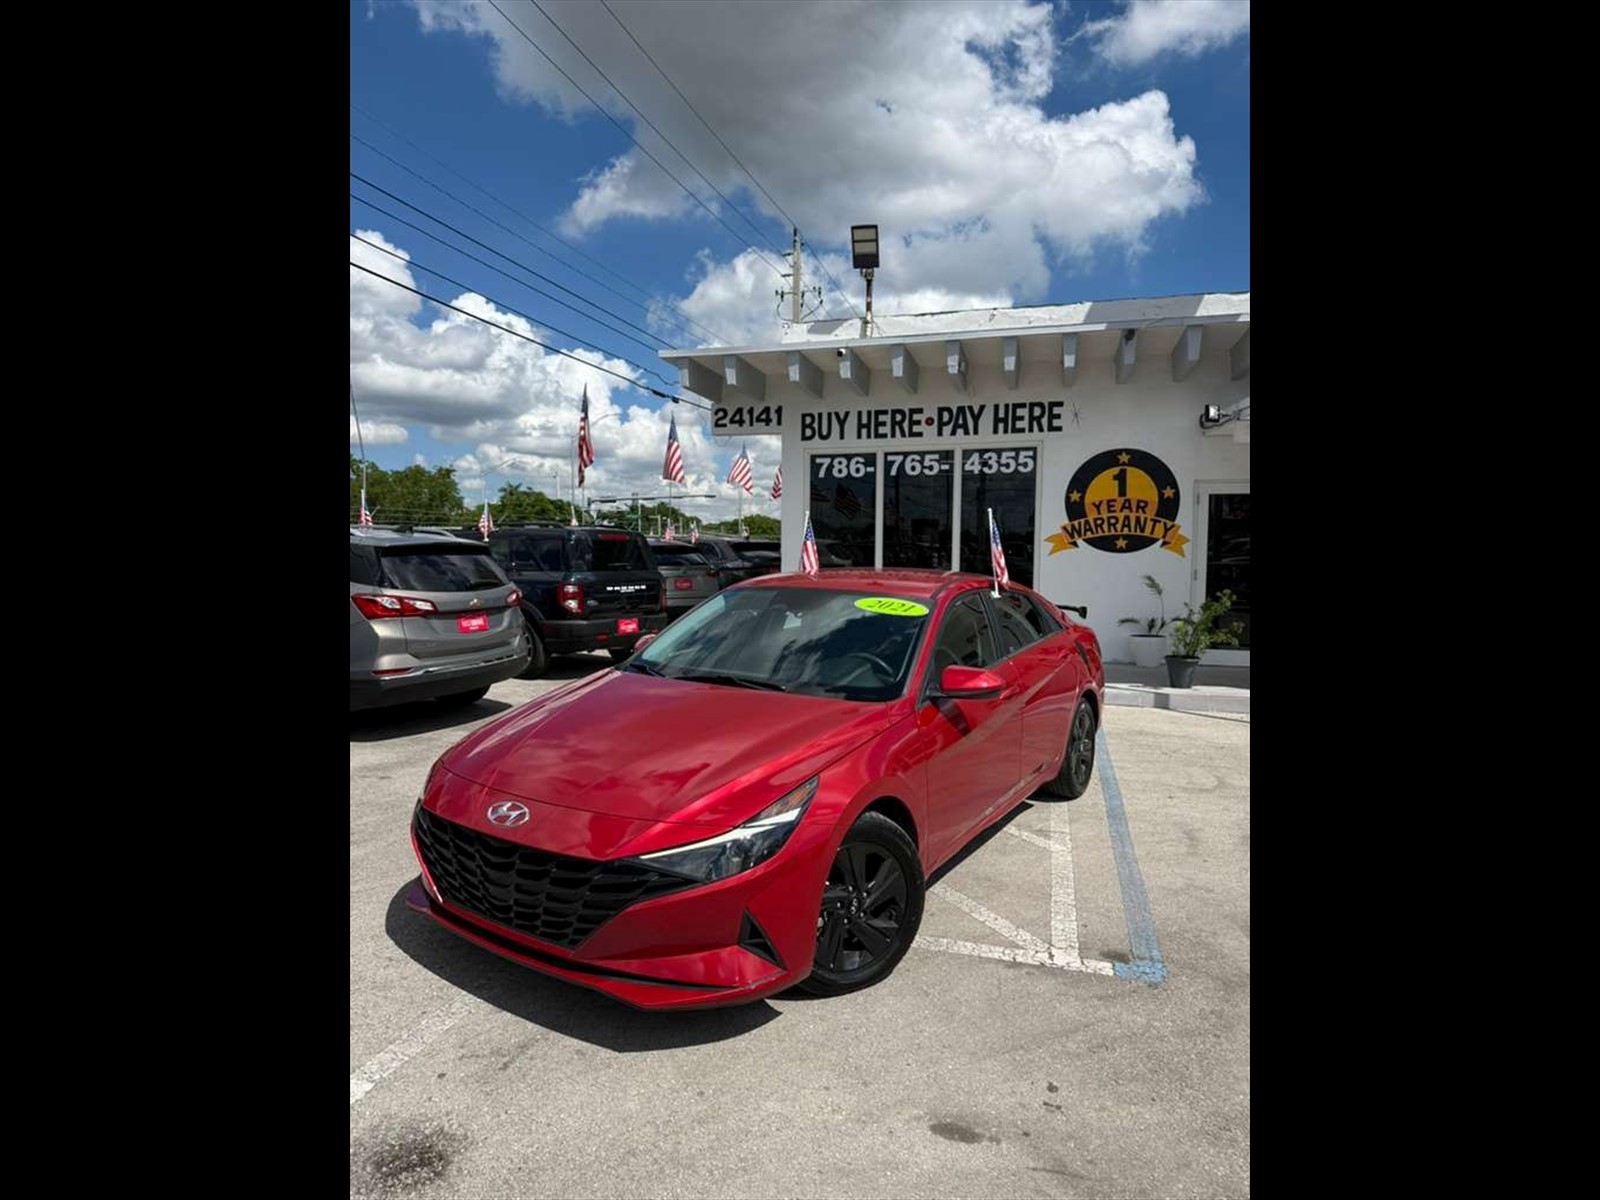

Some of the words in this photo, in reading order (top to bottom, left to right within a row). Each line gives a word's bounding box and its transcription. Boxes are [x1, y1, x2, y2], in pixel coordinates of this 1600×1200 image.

[713, 405, 783, 428] 24141
[801, 412, 850, 441] BUY
[856, 408, 924, 439] HERE
[937, 405, 987, 437] PAY
[993, 401, 1065, 435] HERE
[815, 457, 875, 479] 786-
[886, 454, 950, 477] 765-
[964, 450, 1036, 475] 4355
[1113, 468, 1128, 498] 1
[1091, 499, 1149, 515] YEAR
[1061, 515, 1177, 541] WARRANTY
[864, 599, 916, 613] 2021
